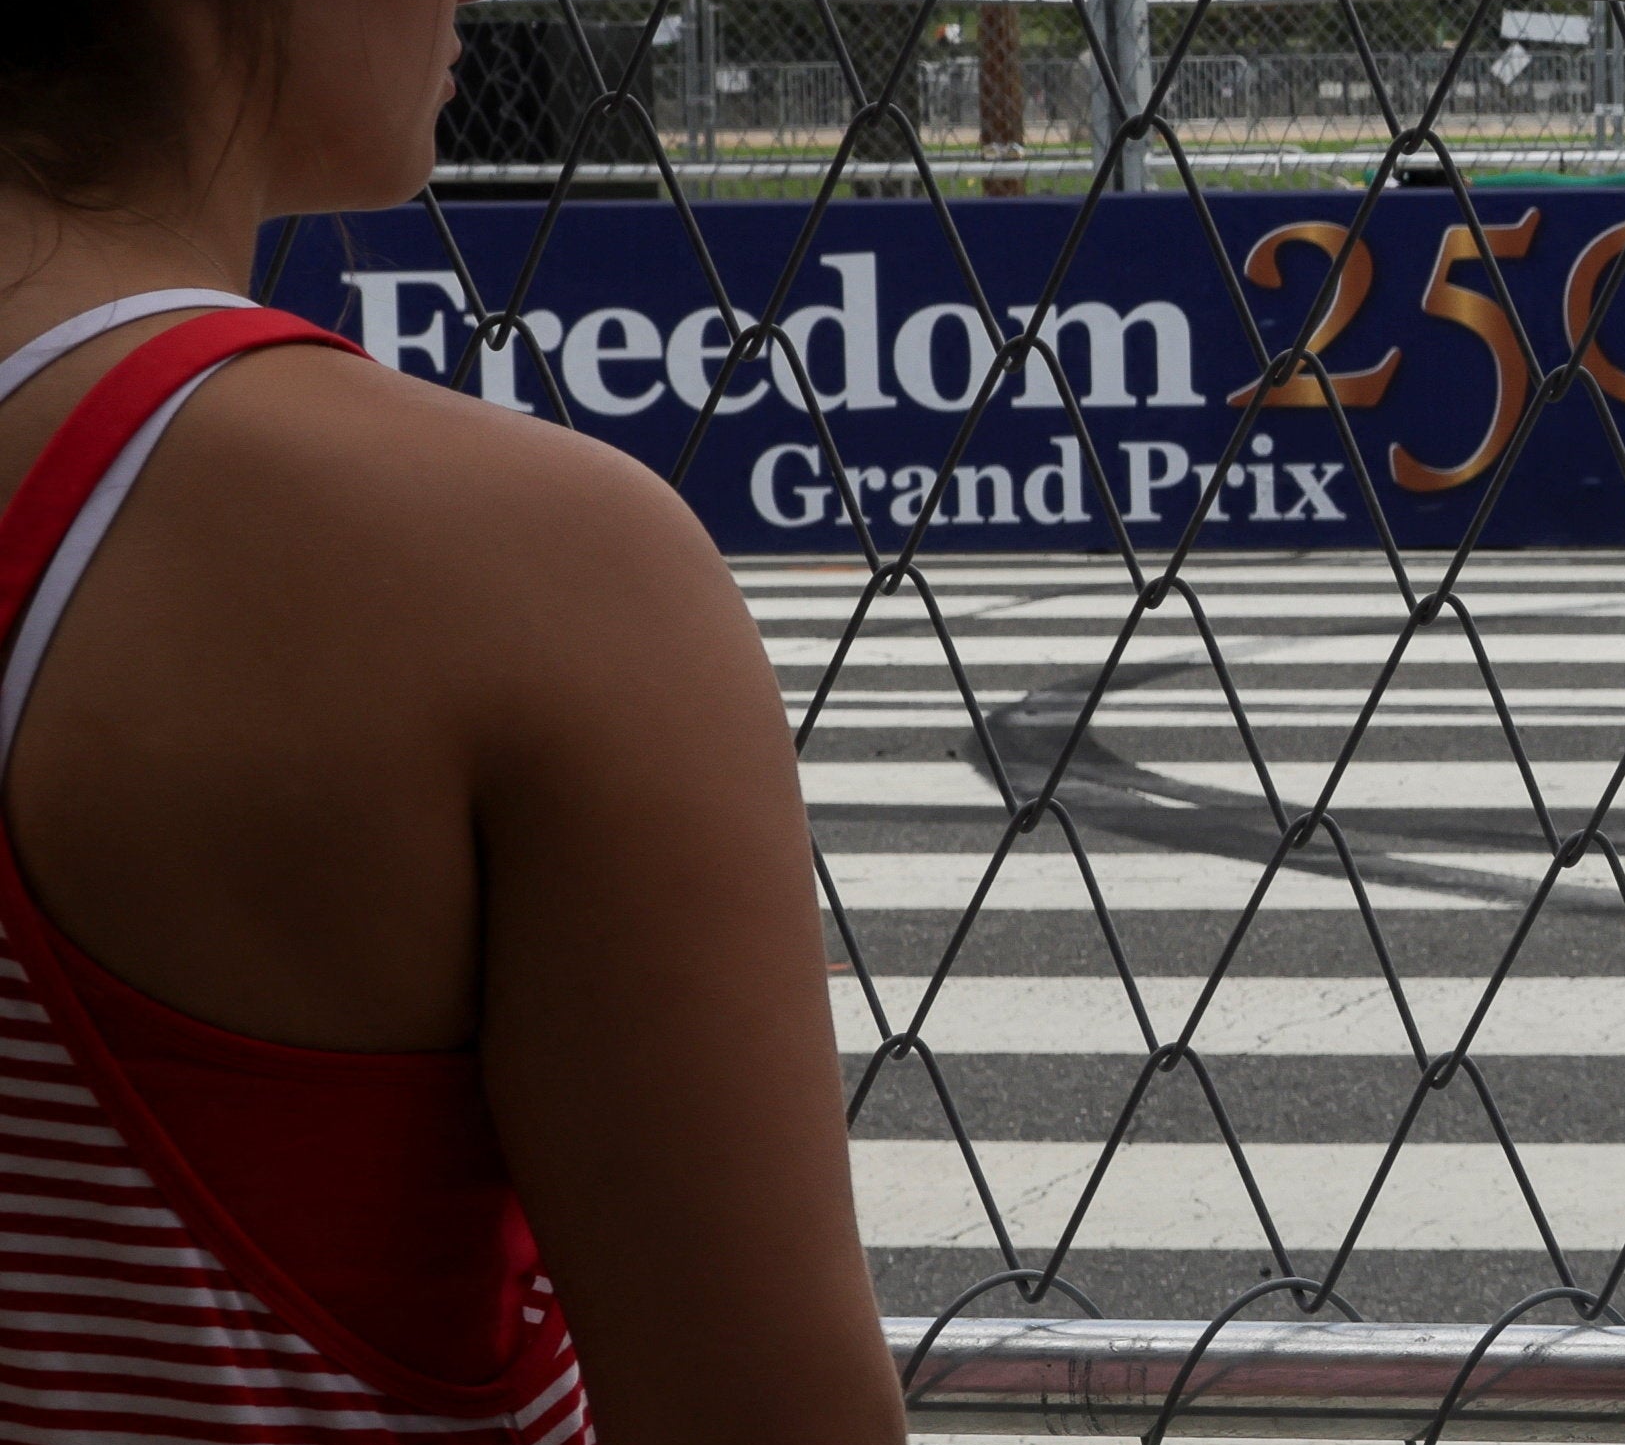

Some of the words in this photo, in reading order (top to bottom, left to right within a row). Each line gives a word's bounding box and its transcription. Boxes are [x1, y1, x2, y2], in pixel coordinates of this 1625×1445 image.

[341, 252, 1206, 417] Freedom
[750, 435, 1092, 528] Grand
[1120, 433, 1347, 523] Prix
